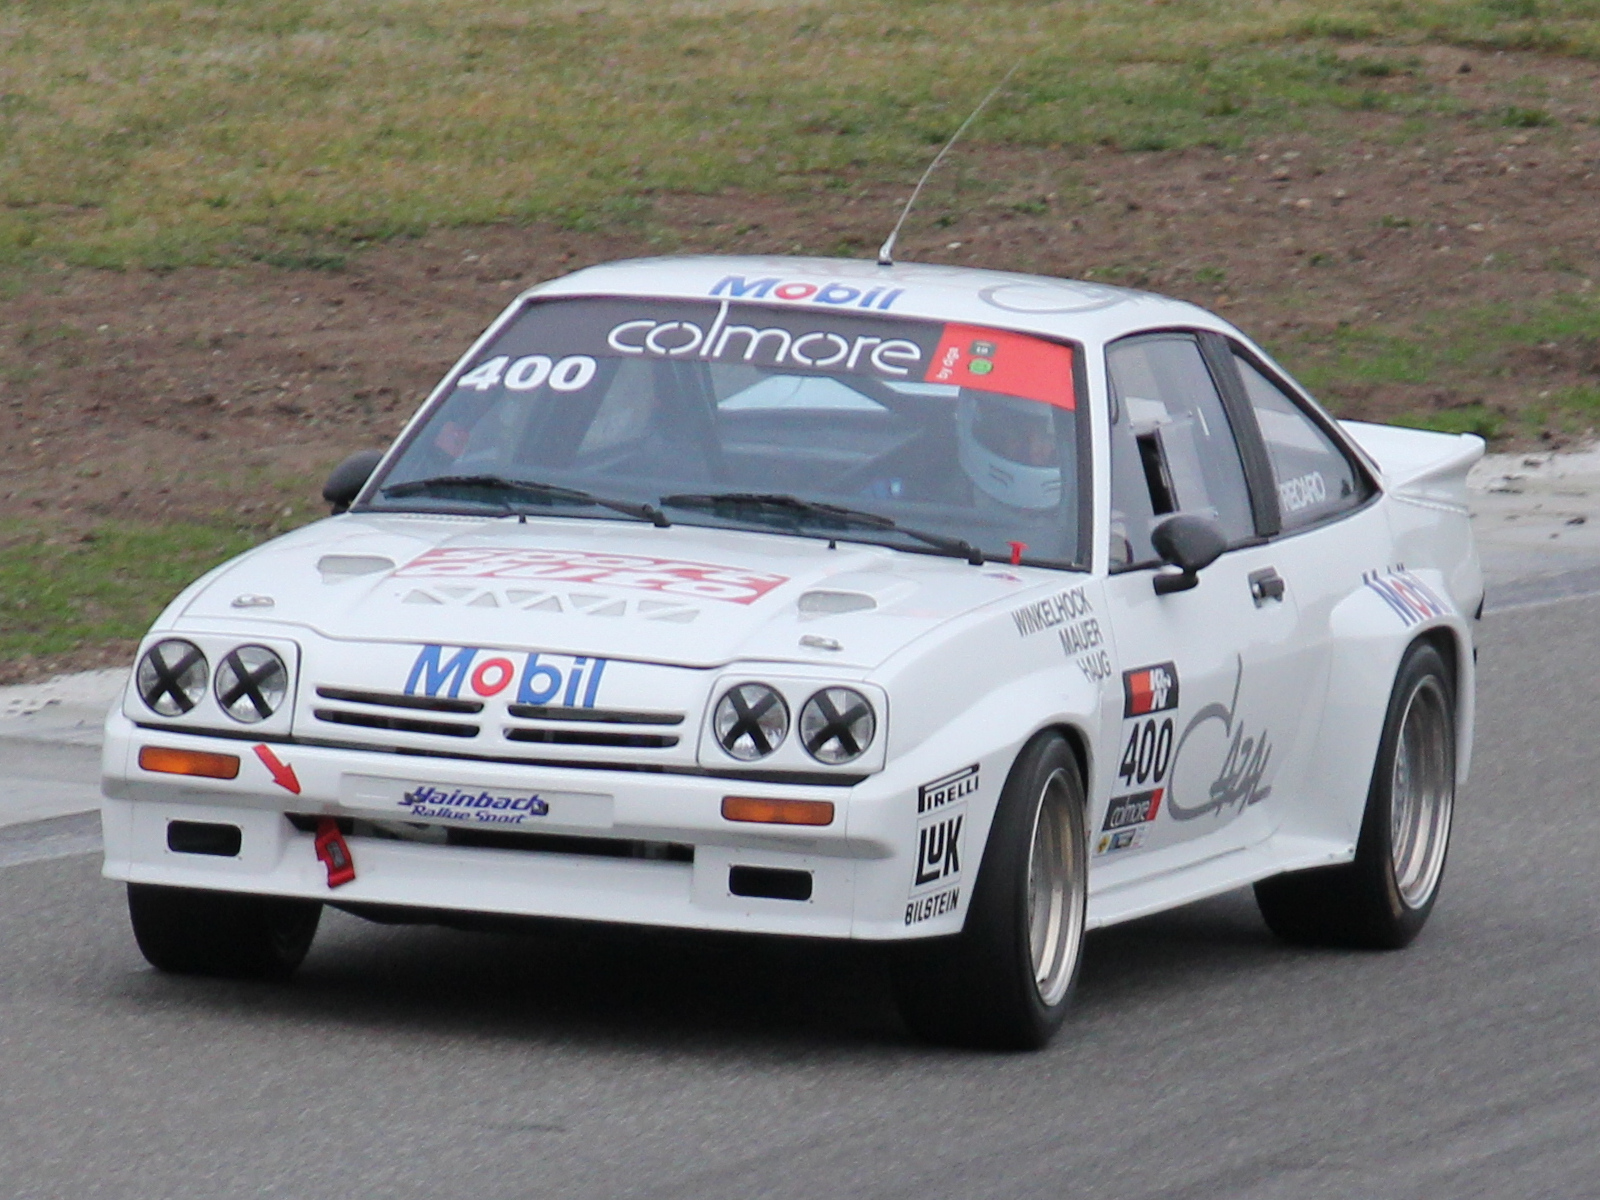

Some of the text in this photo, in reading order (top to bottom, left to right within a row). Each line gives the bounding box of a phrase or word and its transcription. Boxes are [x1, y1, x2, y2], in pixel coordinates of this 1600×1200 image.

[708, 275, 905, 310] Mobil
[607, 298, 921, 375] colmore
[456, 355, 597, 391] 400
[1279, 471, 1326, 511] RECARO
[1011, 586, 1093, 637] WINKELHOCK
[1362, 562, 1453, 627] Mobil
[1059, 618, 1104, 656] MAUER
[403, 644, 608, 709] Mobil
[1076, 650, 1112, 683] HAUG
[1119, 717, 1173, 787] 400
[918, 762, 981, 813] PIRELLI
[905, 887, 960, 926] BILSTEIN
